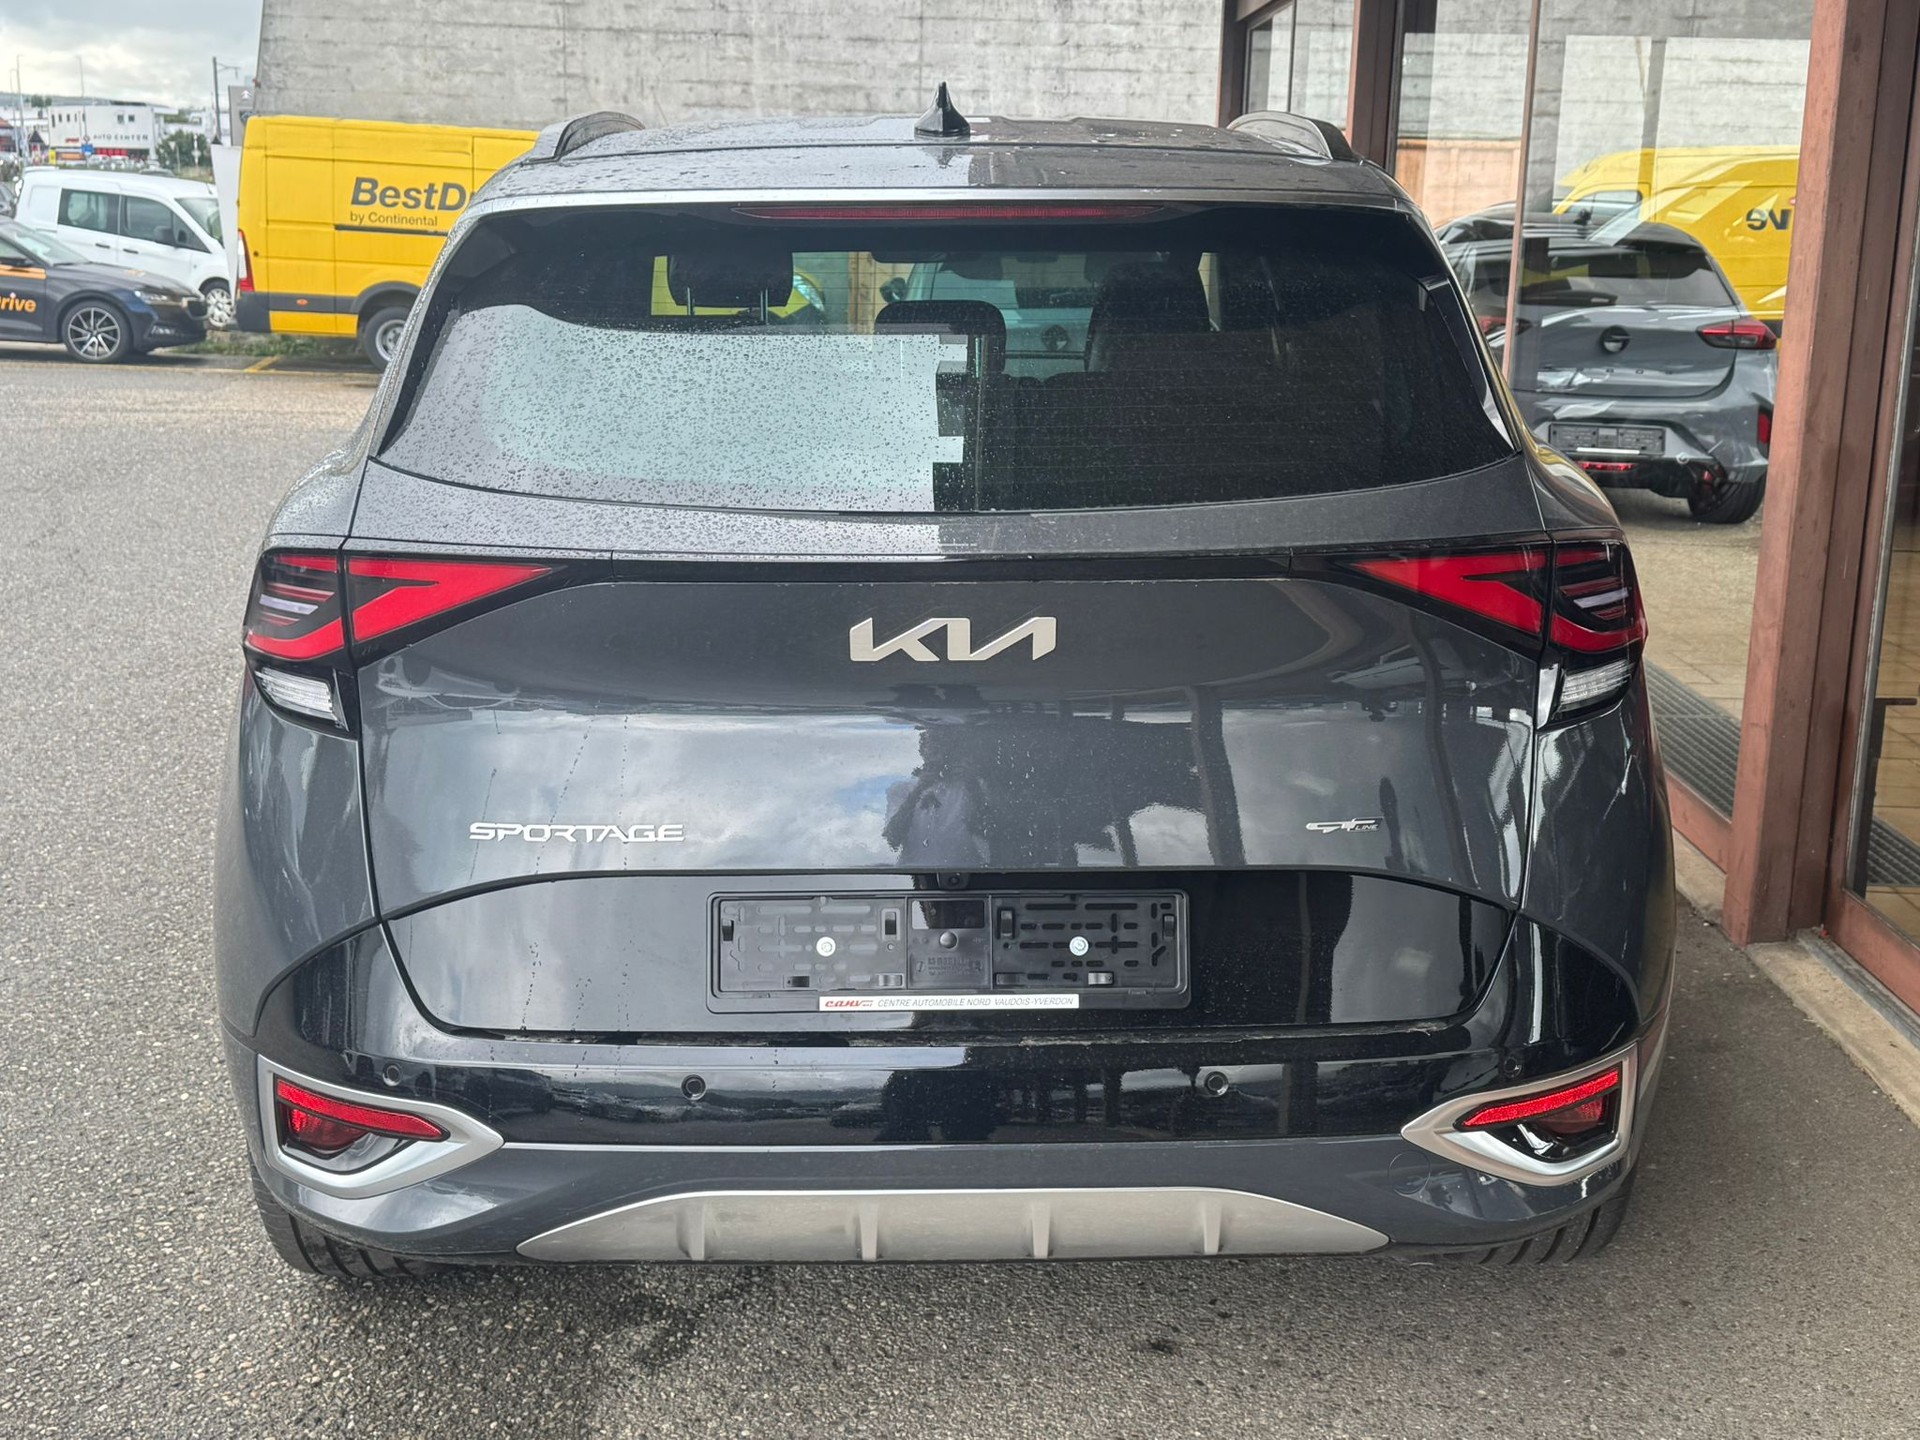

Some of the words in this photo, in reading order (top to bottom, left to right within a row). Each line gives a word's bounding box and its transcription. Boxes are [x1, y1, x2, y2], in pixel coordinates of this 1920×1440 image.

[351, 176, 474, 211] BestD
[350, 211, 365, 224] by
[368, 212, 438, 226] Continental
[0, 292, 37, 313] rive
[849, 617, 1057, 662] KIA
[469, 822, 685, 843] SPORTAGE
[877, 998, 910, 1008] CENTRE
[911, 997, 964, 1007] AUTOMOBILE
[966, 997, 991, 1006] NORD
